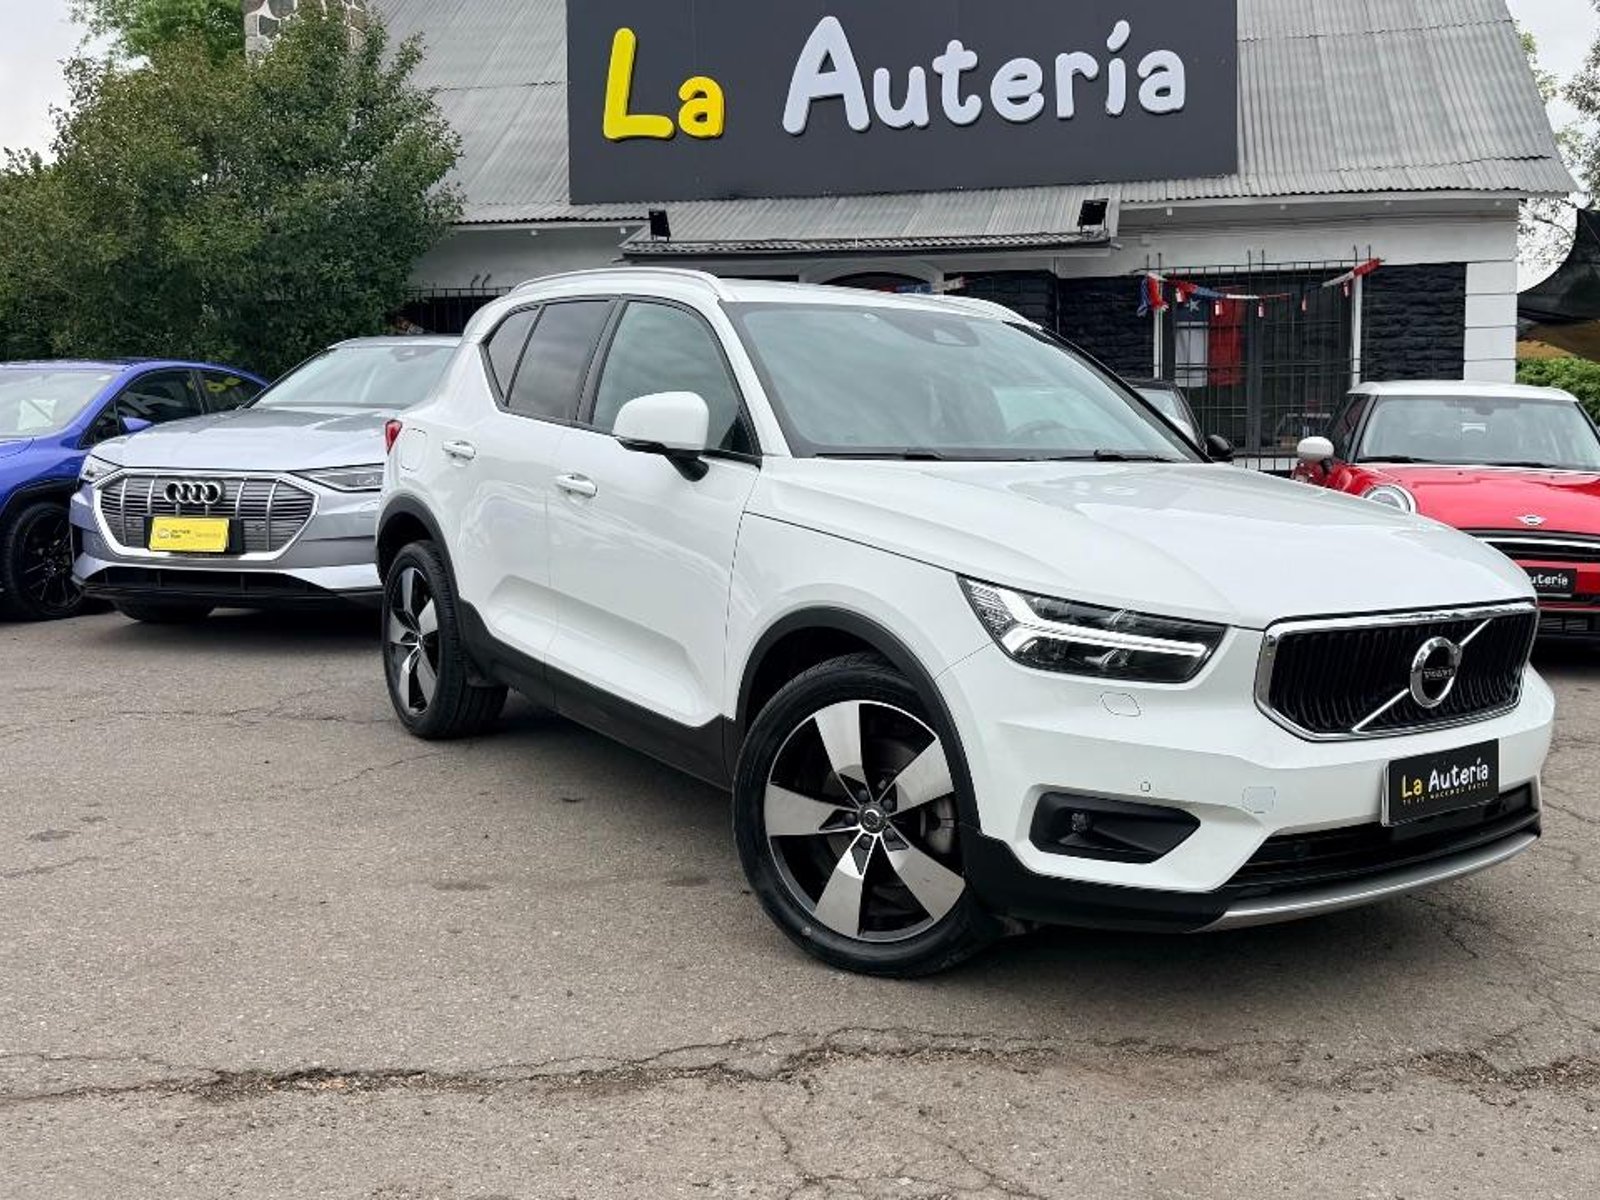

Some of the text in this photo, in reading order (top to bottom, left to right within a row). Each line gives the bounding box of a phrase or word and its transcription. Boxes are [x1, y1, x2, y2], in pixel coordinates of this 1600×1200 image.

[602, 15, 1186, 140] La Autería
[1528, 573, 1568, 586] utería
[1402, 774, 1423, 798] La
[1428, 757, 1489, 792] Autería
